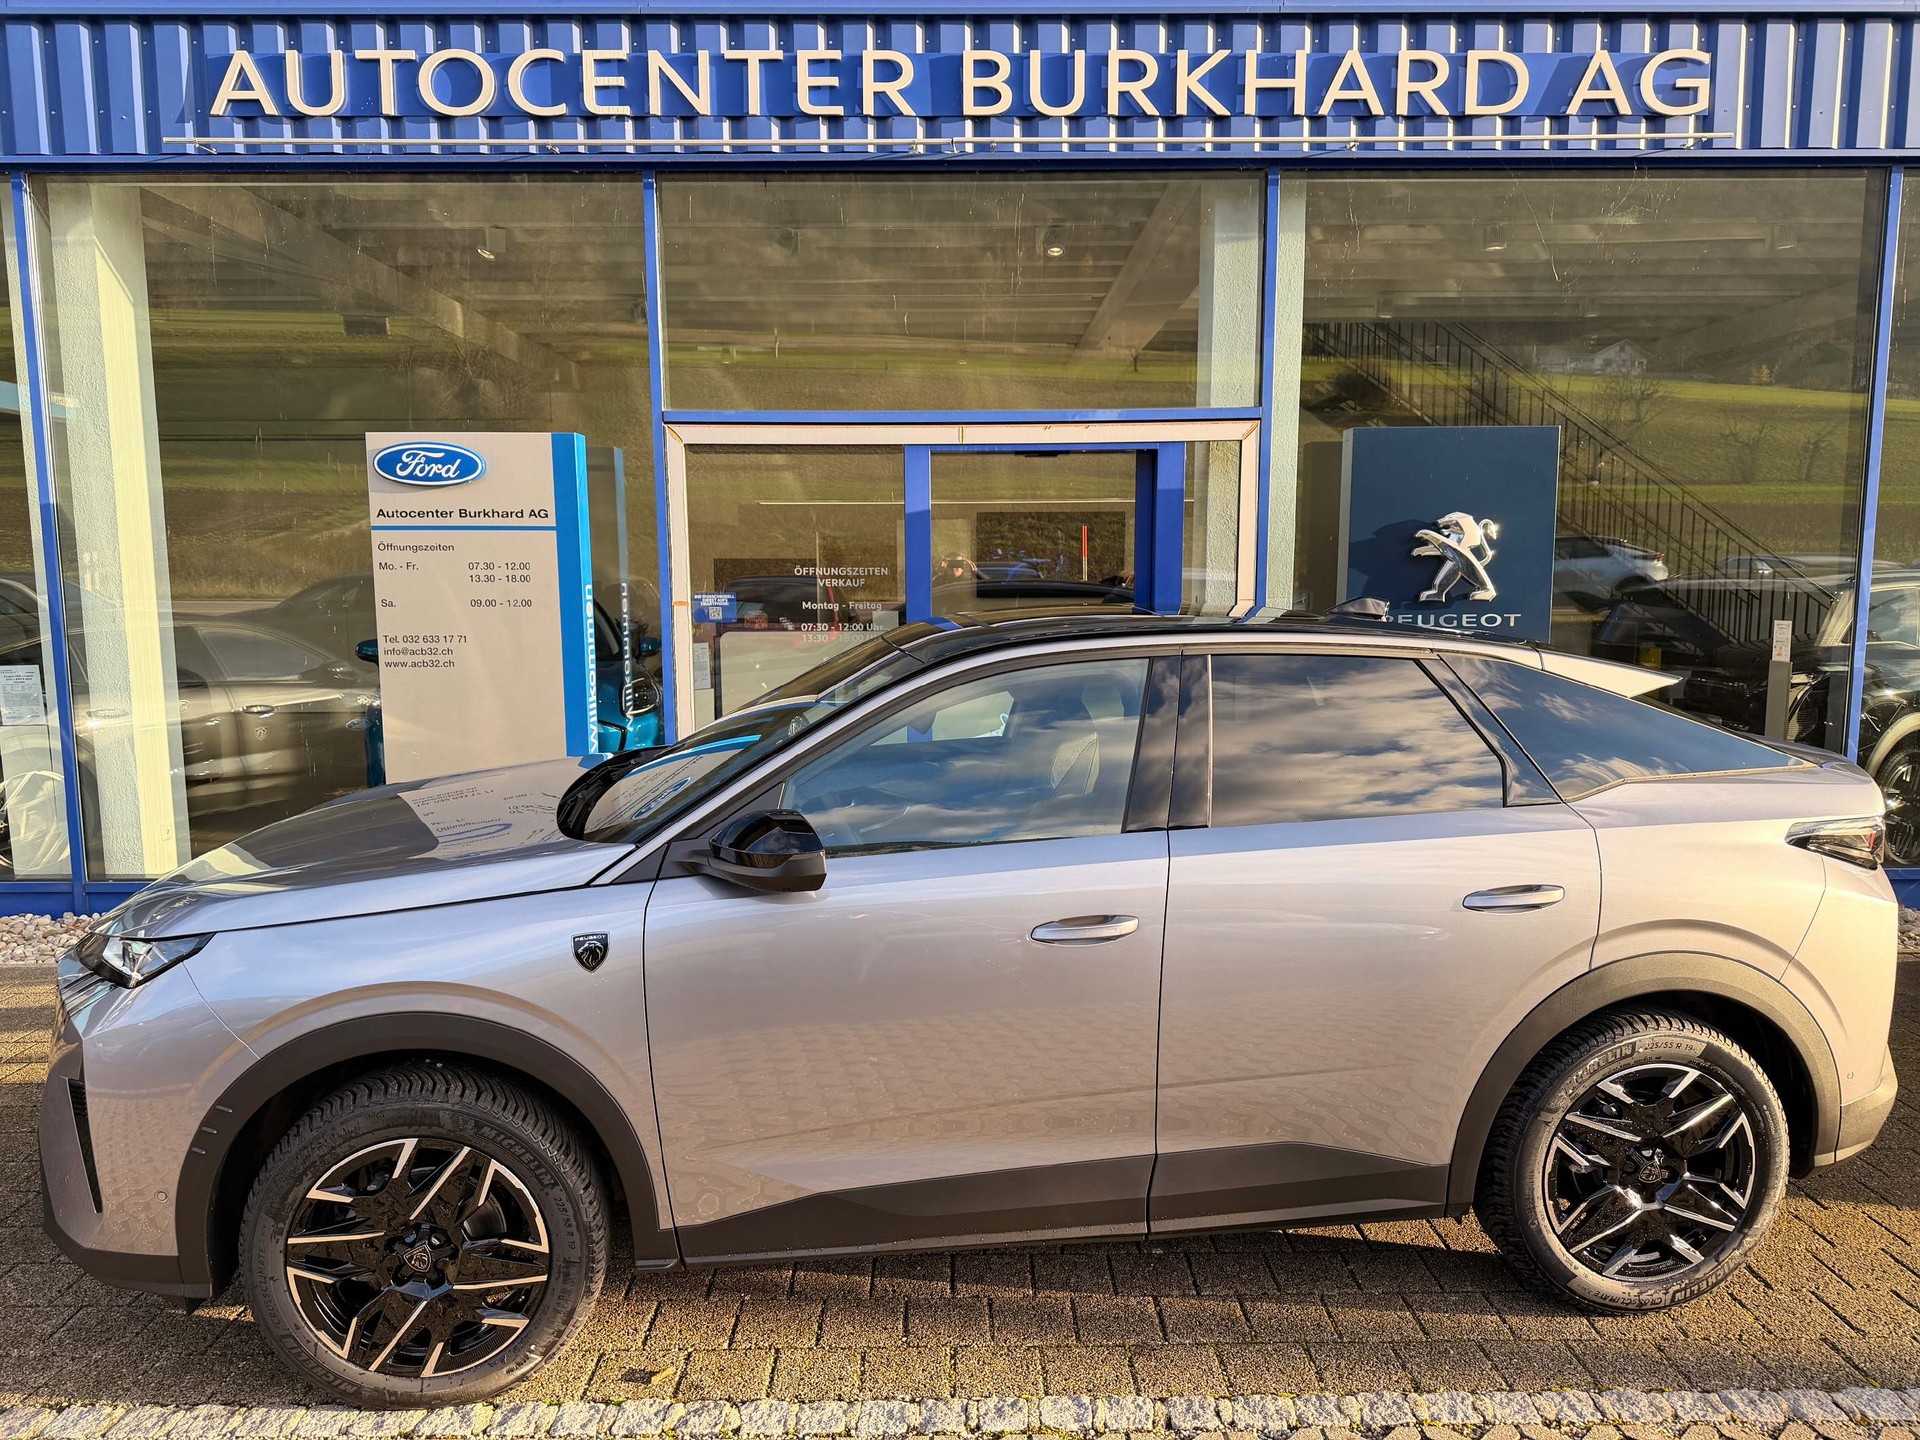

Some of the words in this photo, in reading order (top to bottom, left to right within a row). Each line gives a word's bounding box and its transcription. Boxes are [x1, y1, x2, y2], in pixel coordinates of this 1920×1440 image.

[209, 48, 917, 116] AUTOCENTER
[962, 48, 1531, 116] BURKHARD
[1565, 47, 1712, 116] AG
[396, 450, 462, 478] Ford
[376, 508, 454, 519] Autocenter
[458, 508, 524, 519] Burkhard
[528, 508, 549, 519] AG
[377, 540, 455, 553] Öffnungszeiten
[378, 561, 397, 571] Mo.
[406, 561, 419, 571] Fr.
[468, 561, 495, 571] 07.30
[504, 561, 531, 571] 12.00
[794, 565, 889, 576] ÖFFNUNGSZEITEN
[469, 574, 496, 583] 13.30
[505, 574, 532, 583] 18.00
[817, 578, 866, 587] VERKAUF
[380, 598, 397, 608] Sa.
[470, 598, 497, 608] 09.00
[506, 598, 533, 608] 12.00
[802, 600, 840, 612] Montag
[848, 600, 882, 612] Freitag
[801, 622, 829, 632] 07:30
[839, 622, 864, 632] 12:00
[383, 634, 400, 644] Tel.
[402, 634, 420, 644] 032
[422, 634, 440, 644] 633
[443, 634, 454, 644] 17
[456, 634, 467, 644] 71
[802, 634, 829, 643] 13:30
[383, 646, 454, 657] info@acb32.ch
[384, 659, 455, 668] www.acb32.ch
